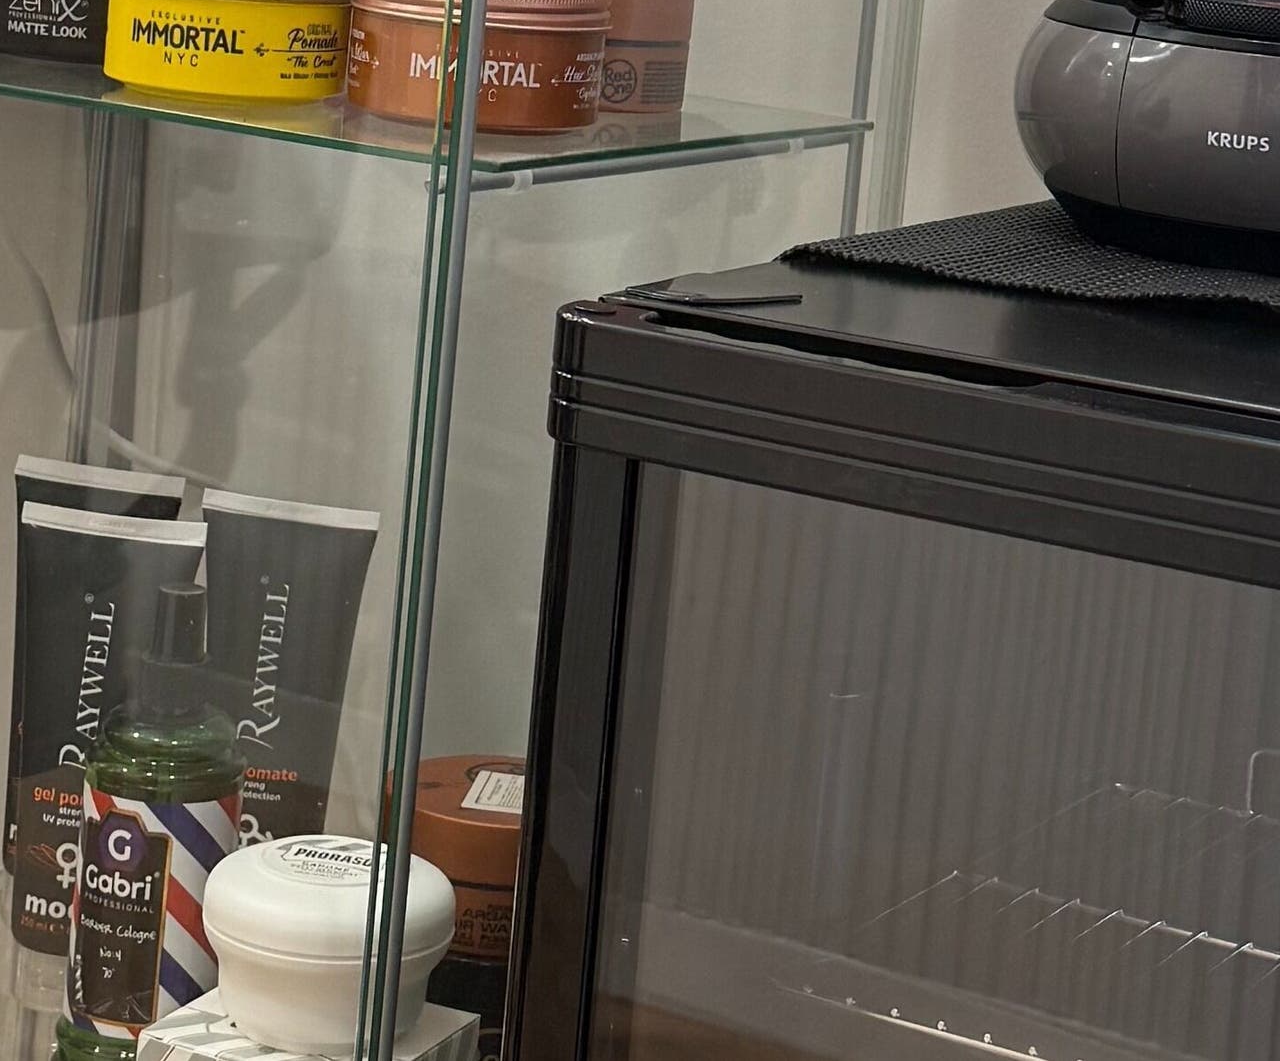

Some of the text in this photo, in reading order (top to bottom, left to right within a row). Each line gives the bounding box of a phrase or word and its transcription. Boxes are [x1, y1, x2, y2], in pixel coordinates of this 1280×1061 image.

[151, 10, 221, 25] EXCLUSIVE
[7, 20, 87, 39] MATTE LOOK
[131, 17, 244, 55] IMMORTAL
[409, 52, 541, 88] IMMRTAL
[1207, 130, 1270, 152] KRUPS
[236, 584, 290, 750] RAYWELL
[34, 787, 56, 801] gel
[43, 814, 55, 823] UV
[108, 829, 132, 862] G
[85, 864, 153, 901] Gabri
[84, 891, 154, 914] PROFESSIONAL
[116, 925, 156, 944] Cologne
